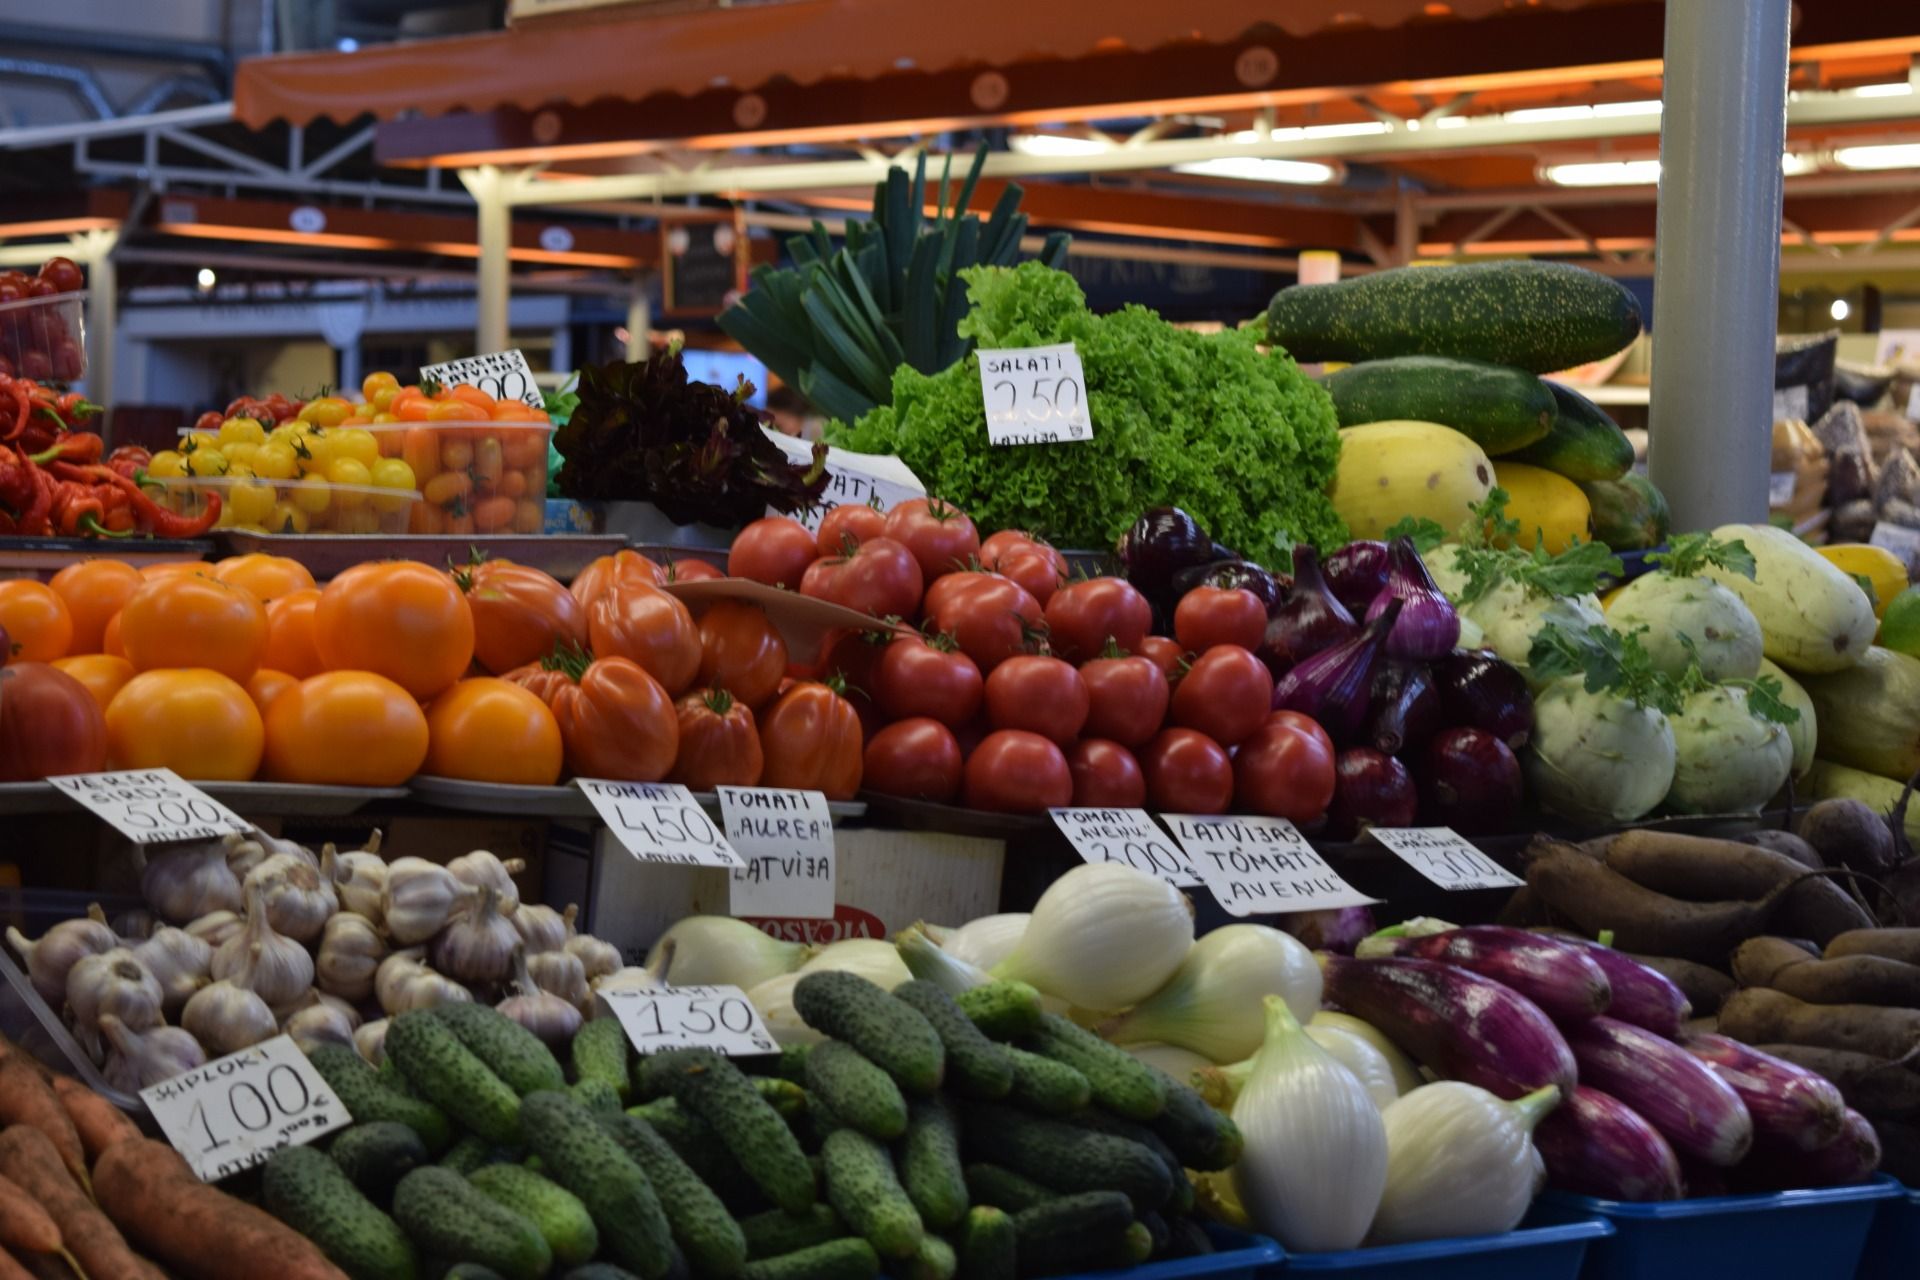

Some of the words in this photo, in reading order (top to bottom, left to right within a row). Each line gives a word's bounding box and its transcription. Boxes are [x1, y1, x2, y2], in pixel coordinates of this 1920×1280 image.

[124, 799, 220, 828] 5.00
[751, 919, 871, 944] VICASO
[637, 998, 752, 1039] 1.50
[181, 1063, 309, 1153] 1.00
